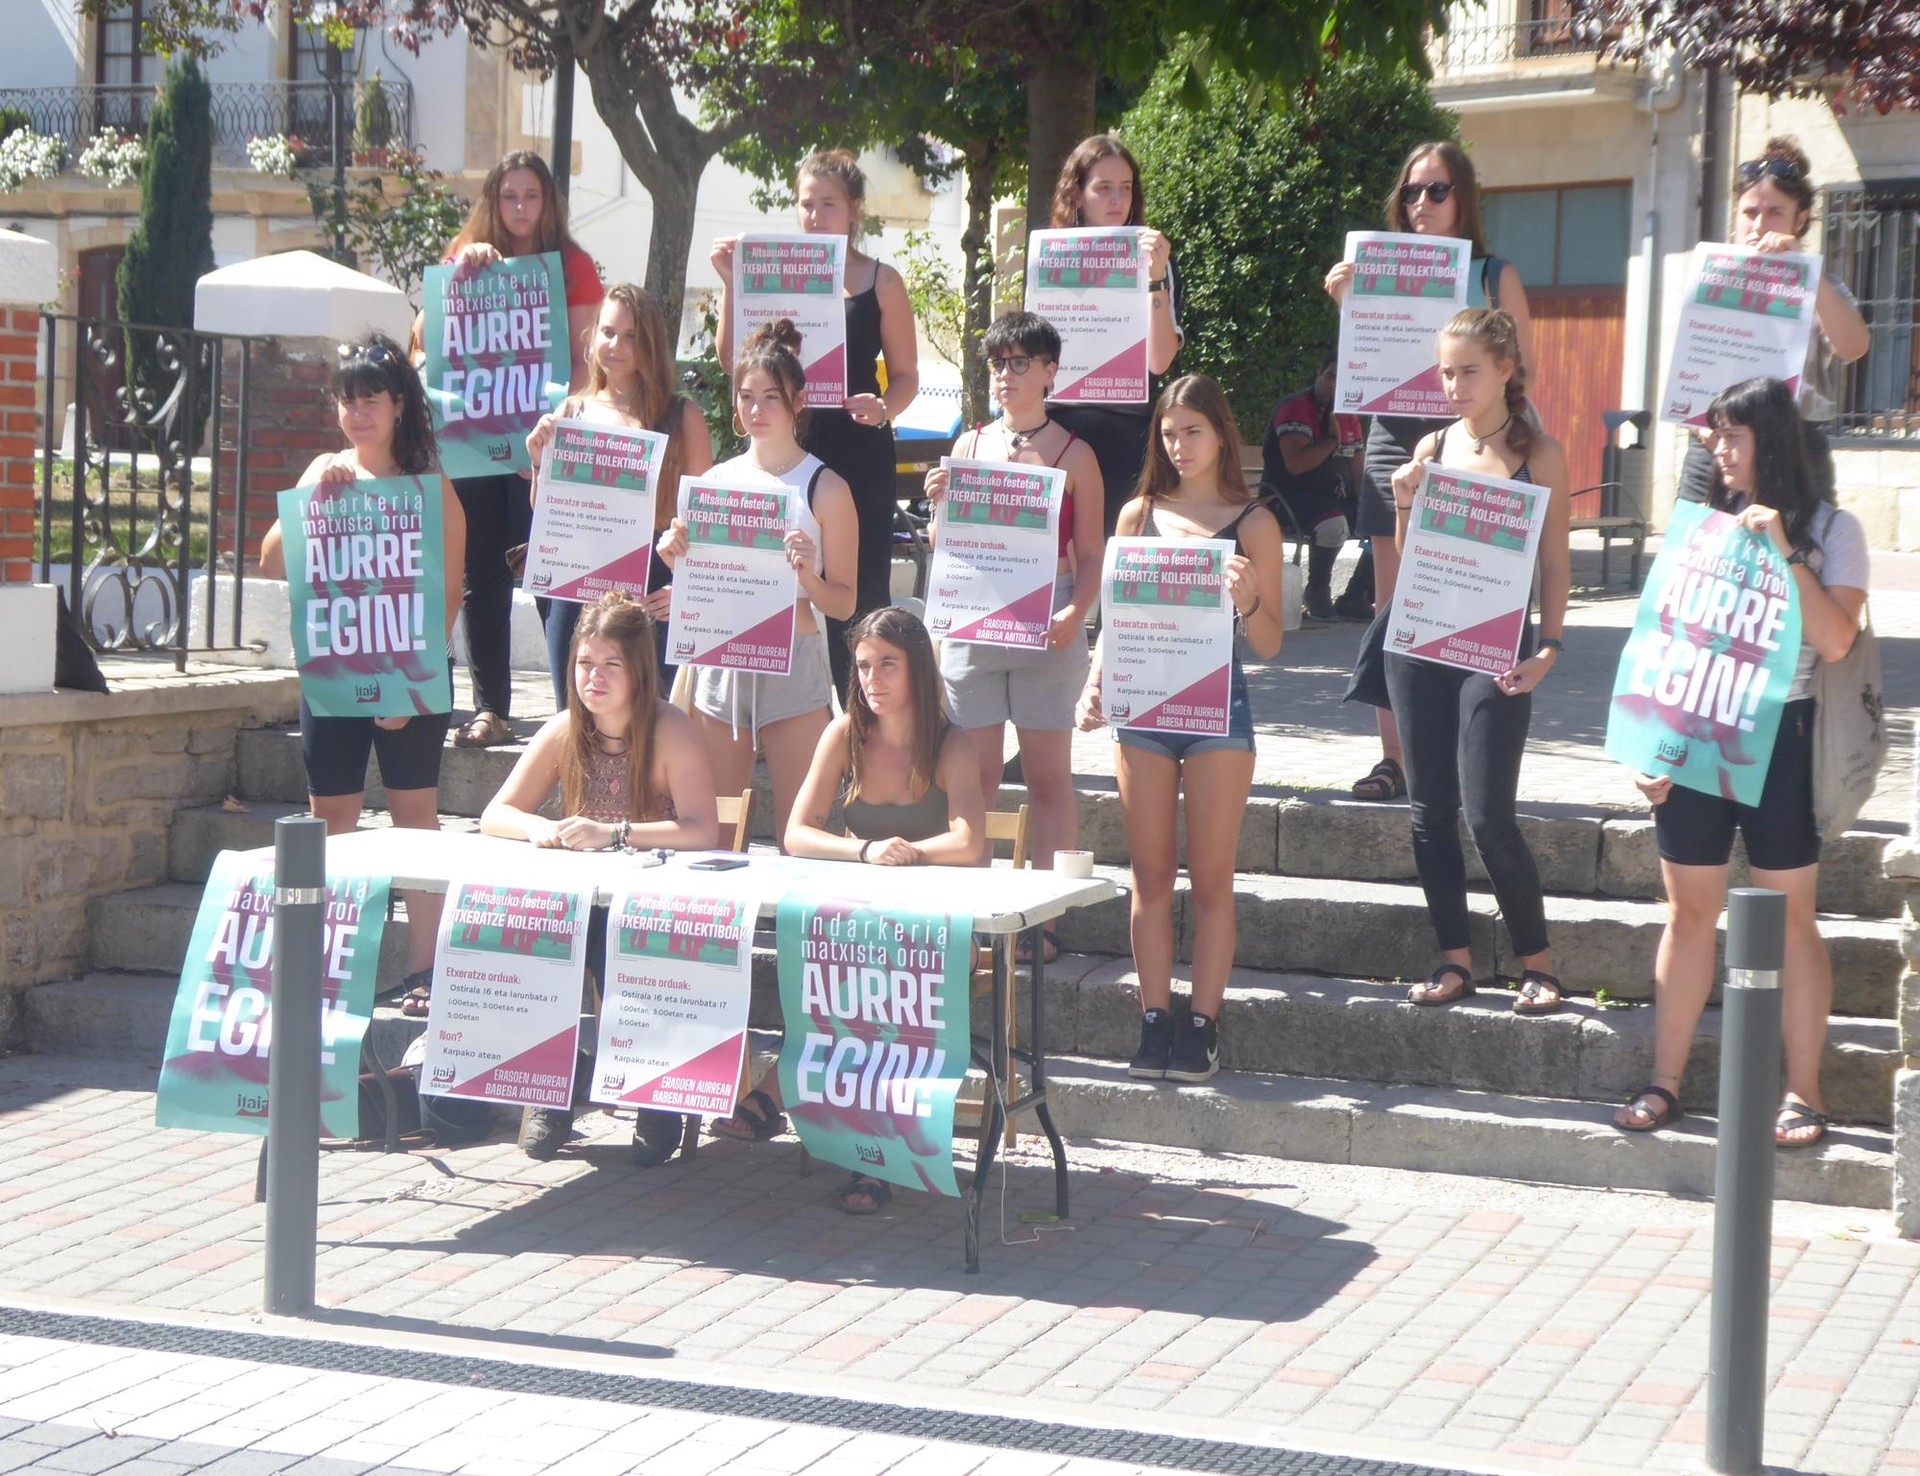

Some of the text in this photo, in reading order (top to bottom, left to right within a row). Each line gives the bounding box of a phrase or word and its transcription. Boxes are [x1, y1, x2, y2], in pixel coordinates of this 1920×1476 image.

[442, 271, 549, 296] Indarkeria
[443, 290, 550, 313] matxista orori
[442, 307, 552, 357] AURRE
[442, 363, 552, 422] EGIN!
[566, 434, 641, 453] Altsasuko festetan
[596, 455, 656, 472] KOLEKTIBOAK
[961, 474, 1039, 489] Altsasuko festetan
[546, 495, 580, 507] Etxeratze
[699, 493, 774, 510] Altsasuko festetan
[993, 494, 1056, 509] KOLEKTIBOAK
[1438, 481, 1521, 510] Altsasuko festetan
[300, 492, 422, 517] Indarkeria
[303, 509, 422, 535] matxista orori
[731, 513, 791, 530] KOLEKTIBOAK
[1470, 506, 1536, 533] KOLEKTIBOAK
[539, 545, 558, 554] Non?
[946, 538, 978, 549] Etxeratze
[305, 532, 423, 583] AURRE
[1126, 552, 1208, 566] Altsasuko festetan
[1415, 545, 1449, 561] Etxeratze
[686, 558, 719, 570] Etxeratze
[615, 581, 642, 593] AURREAN
[939, 588, 958, 598] Non?
[1754, 570, 1790, 599] orori
[1404, 599, 1424, 611] Non?
[1654, 566, 1789, 651] AURRE
[681, 611, 699, 620] Non?
[1113, 619, 1148, 629] Etxeratze
[307, 593, 426, 656] EGIN!
[1015, 621, 1044, 633] AURREAN
[758, 645, 787, 657] AURREAN
[1481, 644, 1512, 660] AURREAN
[1113, 673, 1132, 682] Non?
[1629, 630, 1770, 732] EGIN!
[1194, 706, 1224, 717] AURREAN
[472, 890, 563, 911] Altsasuko festetan
[637, 896, 730, 916] Altsasuko festetan
[328, 899, 363, 921] rori
[507, 914, 581, 935] KOLEKTIBOAK
[674, 920, 748, 941] KOLEKTIBOAK
[801, 910, 947, 946] Indarkeria
[204, 911, 358, 980] AUE
[802, 938, 946, 970] matxista orori
[447, 967, 486, 981] Etxeratze
[618, 974, 656, 986] Etxeratze
[450, 984, 480, 994] Ostirala
[494, 989, 507, 997] eta
[510, 990, 548, 1001] larunbata
[622, 991, 651, 1001] Ostirala
[665, 995, 677, 1003] eta
[680, 997, 716, 1007] larunbata
[802, 962, 945, 1029] AURRE
[187, 980, 347, 1065] EGI!
[439, 1030, 462, 1042] Non?
[611, 1037, 633, 1048] Non?
[443, 1047, 501, 1060] Karpako atean
[614, 1055, 669, 1067] Karpako atean
[531, 1073, 567, 1088] AURREAN
[797, 1032, 945, 1118] EGIN!
[698, 1080, 731, 1095] AURREAN
